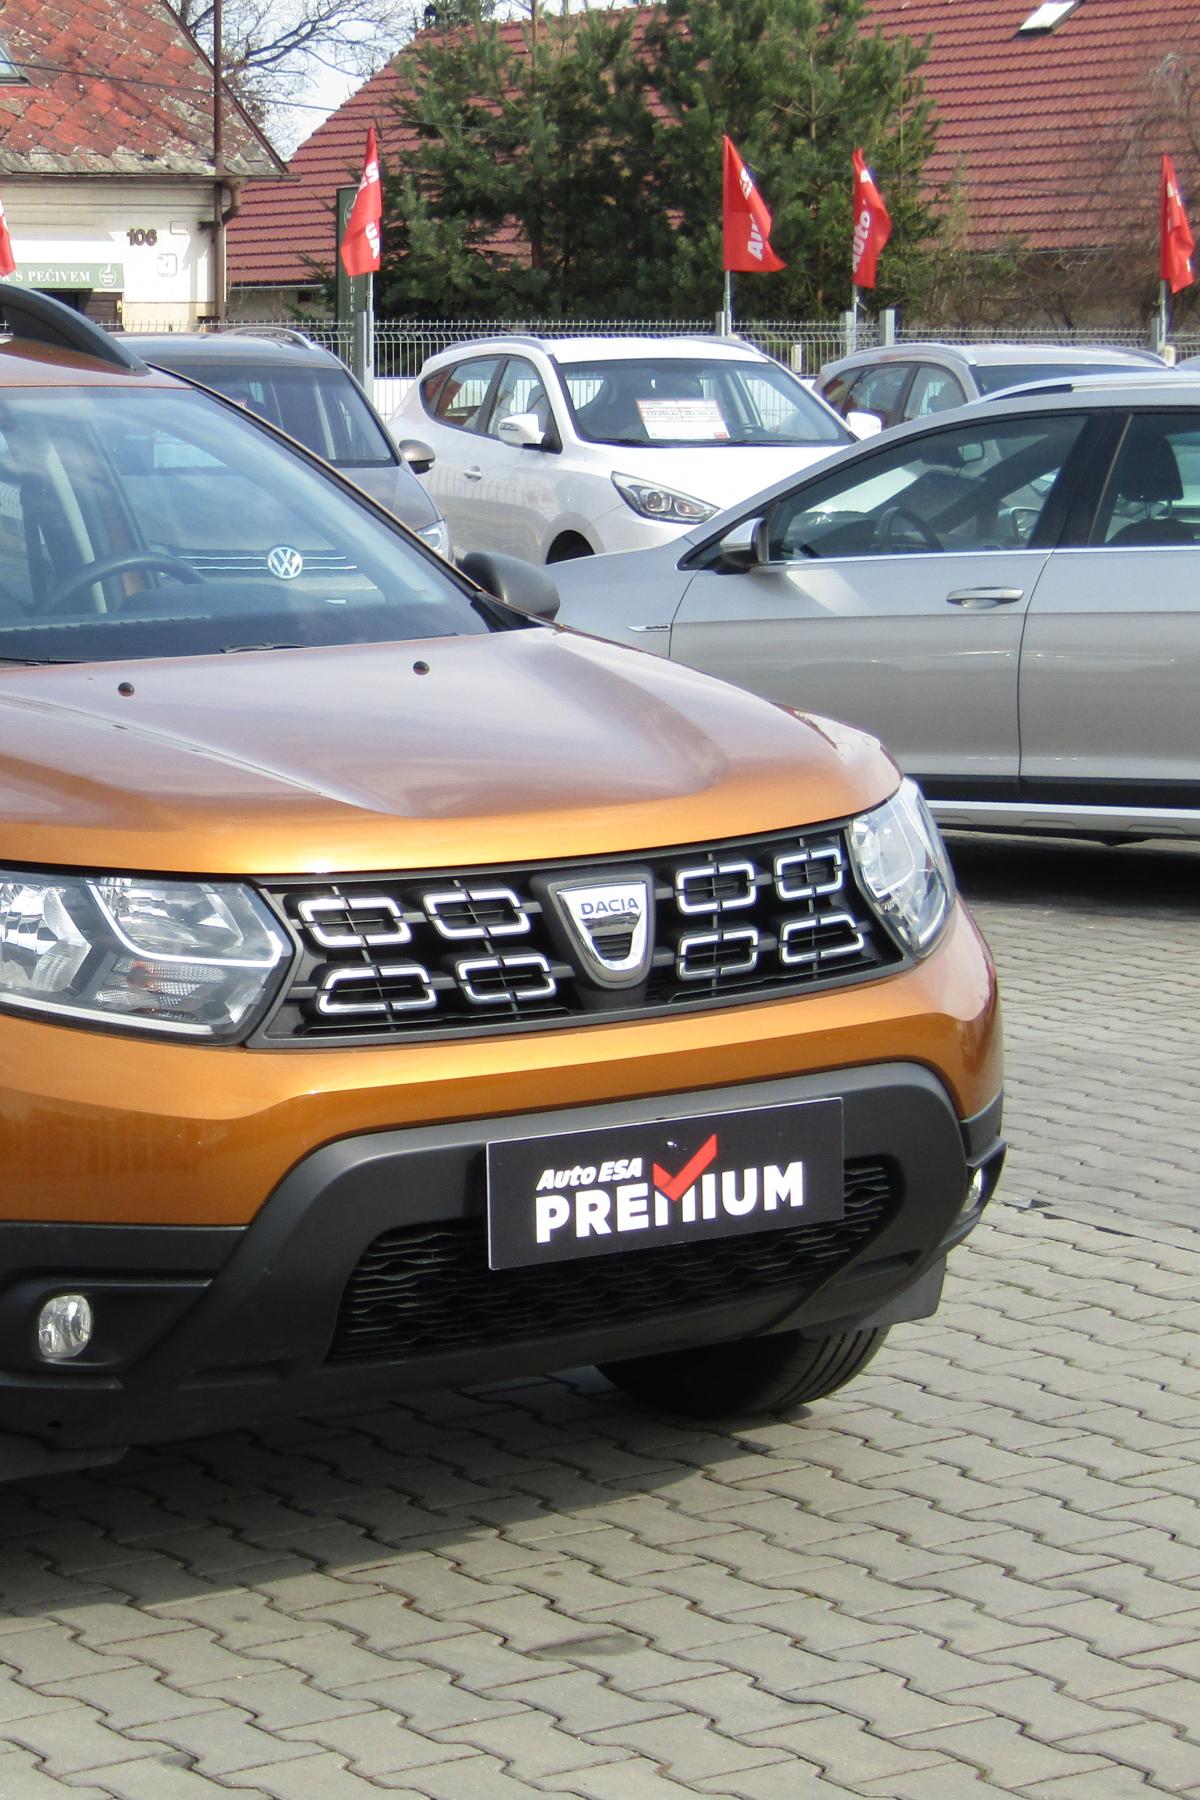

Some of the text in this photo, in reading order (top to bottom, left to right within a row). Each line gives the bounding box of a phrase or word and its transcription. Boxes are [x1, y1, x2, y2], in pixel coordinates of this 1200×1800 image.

[127, 228, 158, 246] 106
[15, 270, 24, 282] S
[28, 268, 91, 283] PEČIVEM
[580, 897, 640, 915] DACIA
[536, 1157, 643, 1191] Auto ESA
[535, 1161, 804, 1244] PREMIUM
